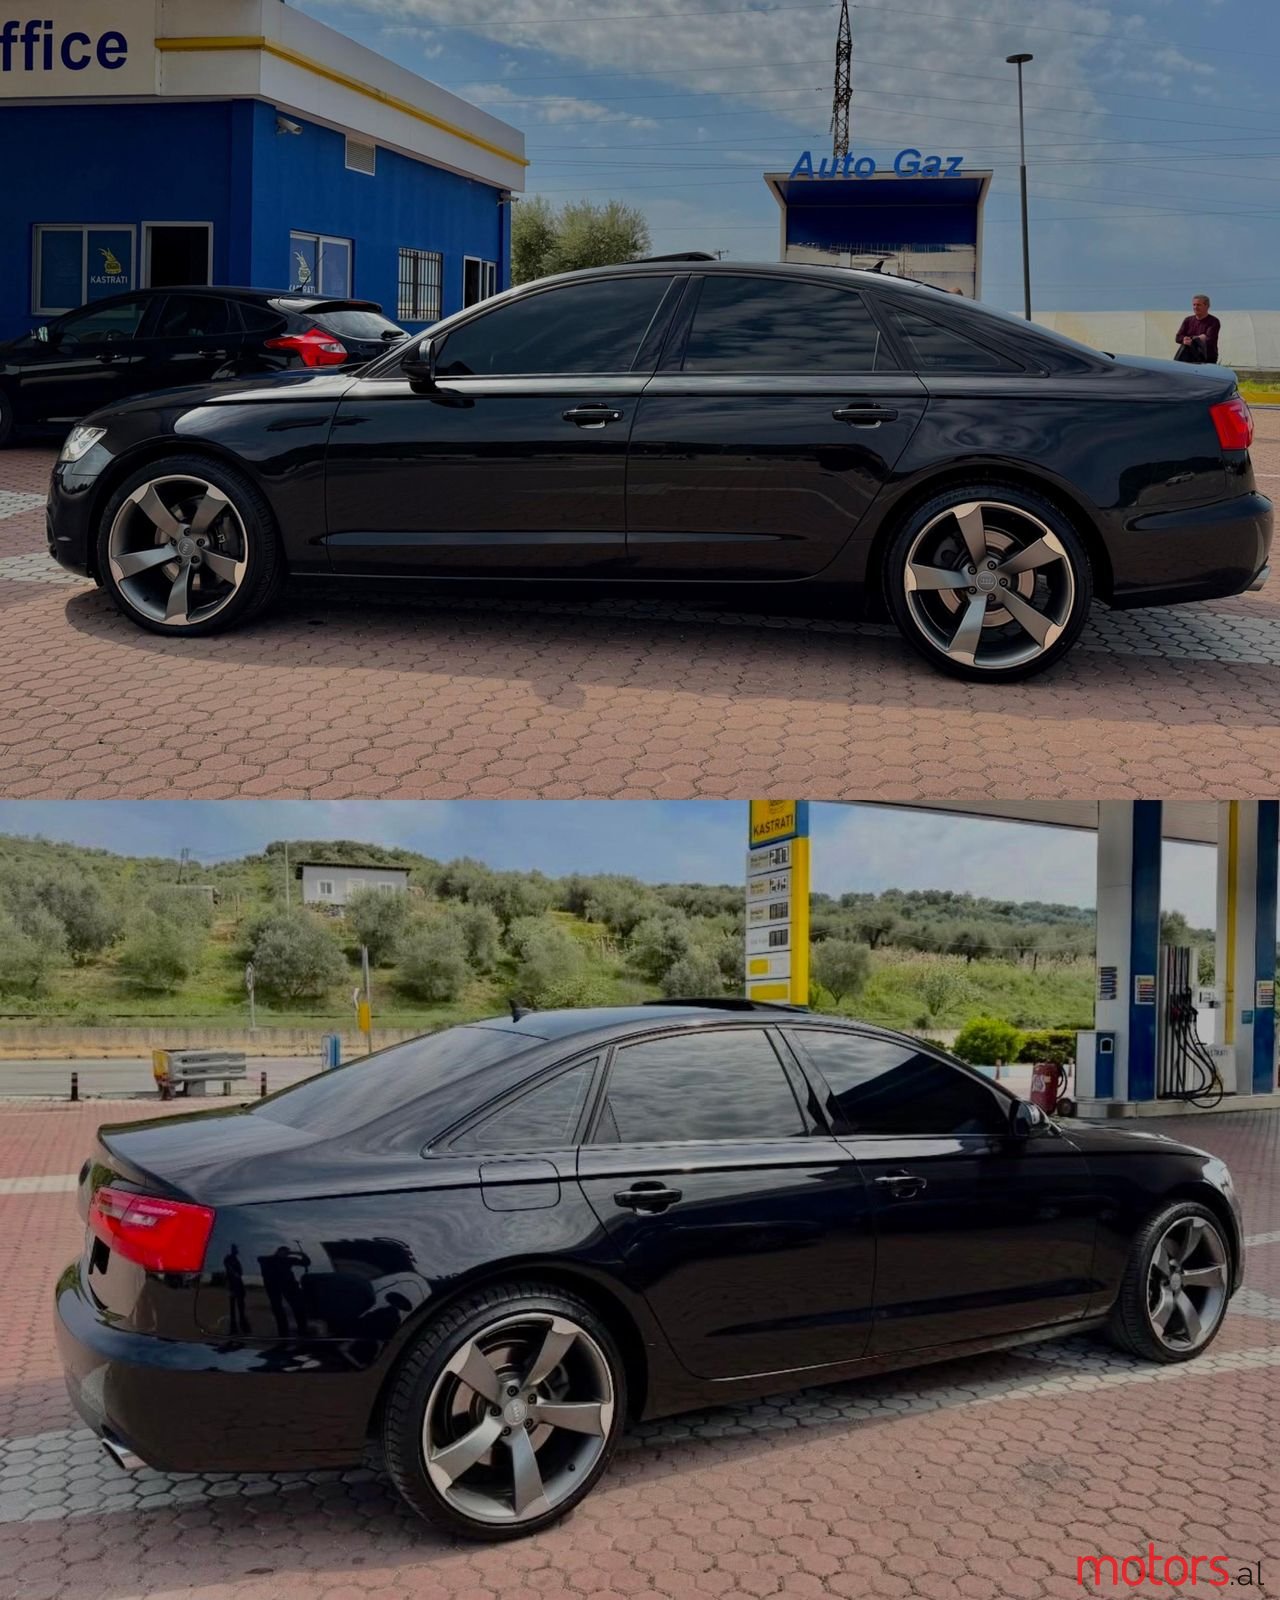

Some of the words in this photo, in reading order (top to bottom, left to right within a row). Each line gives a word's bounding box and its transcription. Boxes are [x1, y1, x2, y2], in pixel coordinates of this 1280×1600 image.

[0, 20, 128, 71] ffice
[789, 151, 876, 179] Auto
[893, 148, 964, 178] Gaz
[90, 275, 128, 284] KASTRATI
[753, 814, 794, 839] KASTRATI
